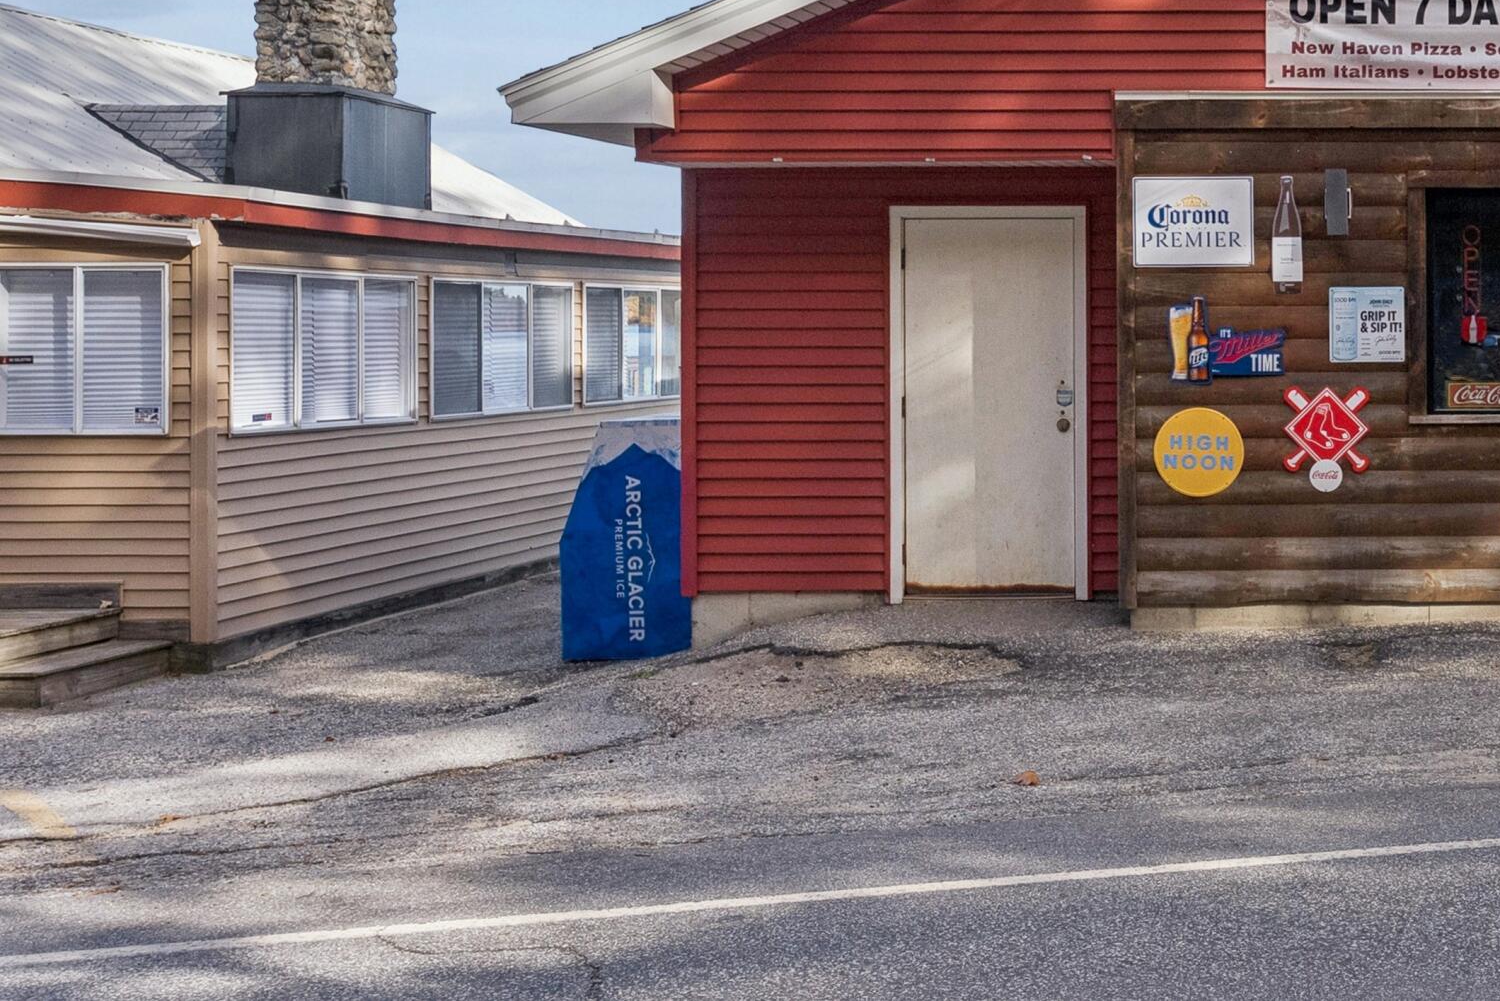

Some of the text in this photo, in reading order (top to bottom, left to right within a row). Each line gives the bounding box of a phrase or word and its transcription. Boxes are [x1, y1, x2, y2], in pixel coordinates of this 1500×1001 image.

[1291, 42, 1334, 55] New
[1342, 42, 1403, 55] Haven
[1410, 42, 1462, 56] Pizza
[1281, 65, 1326, 79] Ham
[1334, 65, 1409, 79] Italians
[1148, 204, 1230, 231] Corona
[1142, 231, 1243, 248] PREMIER
[1360, 310, 1397, 321] GRIP IT
[1360, 322, 1402, 333] & SIP IT!
[1250, 354, 1280, 372] TIME
[1169, 434, 1229, 451] HIGH
[1164, 454, 1234, 470] NOON
[614, 518, 625, 599] PREMIUM ICE
[625, 475, 646, 641] ARCTIC GLACIER
